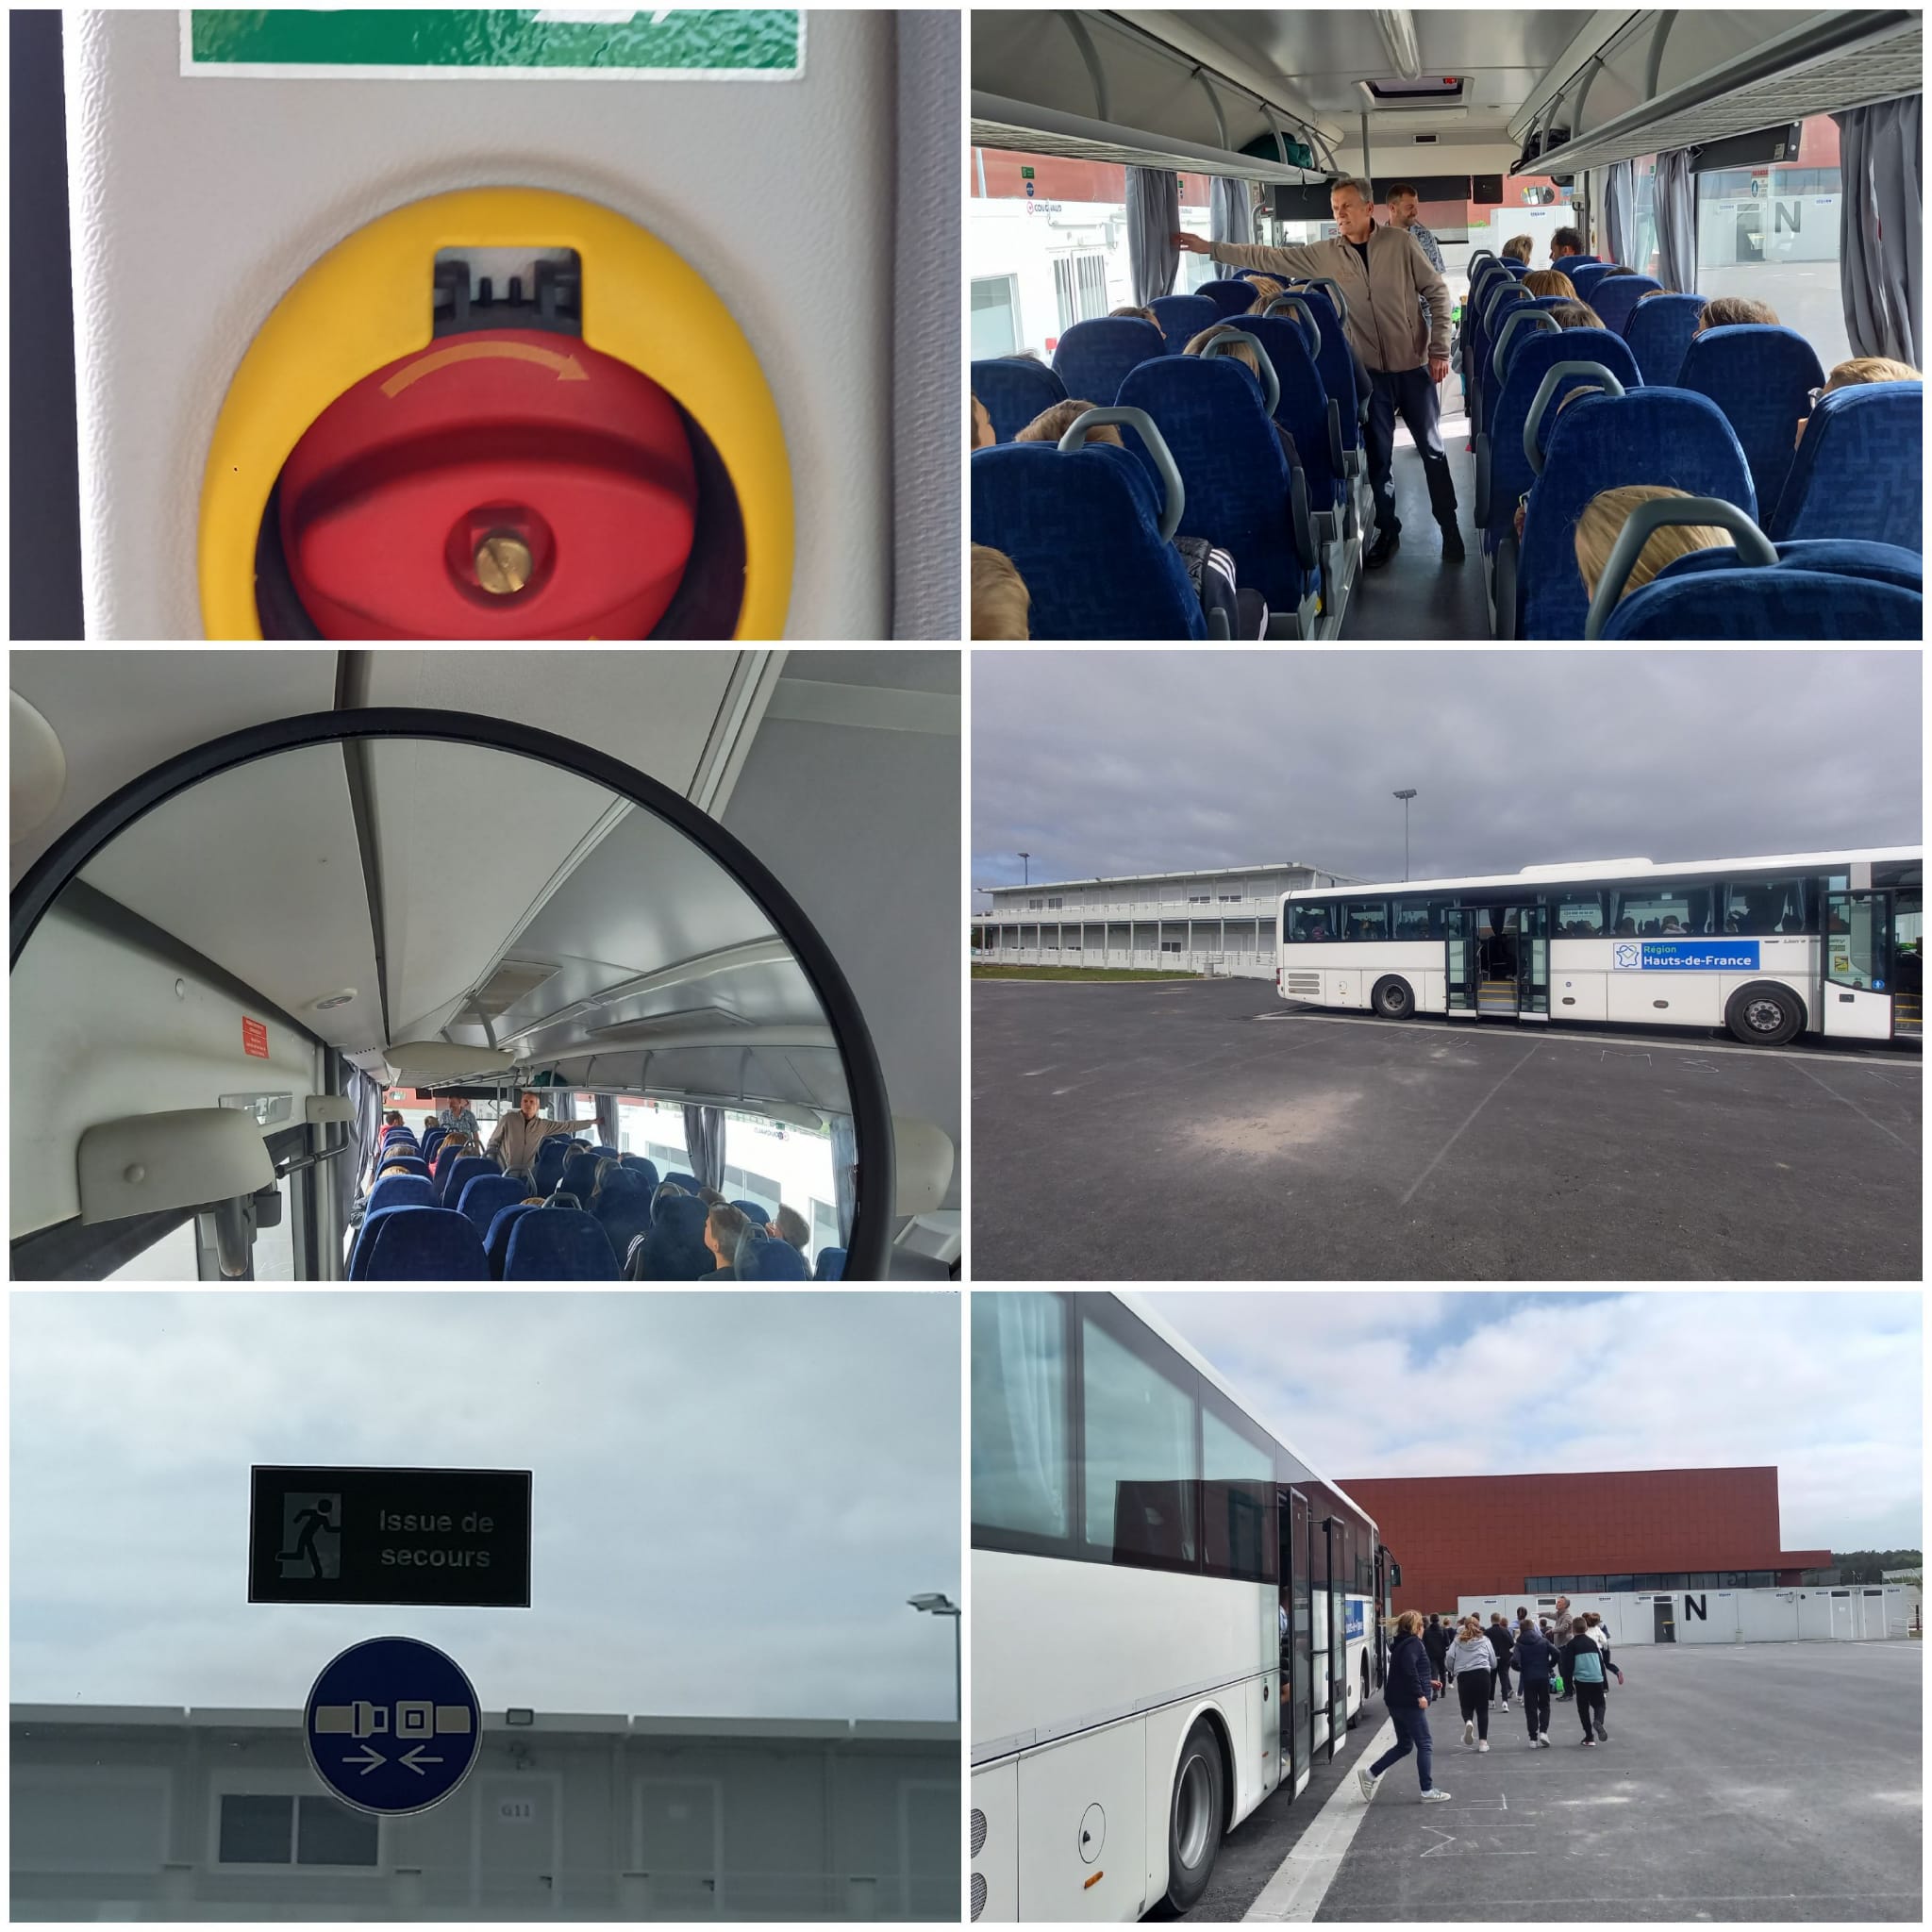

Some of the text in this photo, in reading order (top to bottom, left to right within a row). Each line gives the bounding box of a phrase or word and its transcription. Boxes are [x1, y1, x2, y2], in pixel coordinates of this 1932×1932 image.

[1774, 201, 1801, 233] N
[1643, 945, 1677, 955] Région
[1643, 956, 1752, 966] Hauts-de-France
[379, 1509, 494, 1533] Issue de
[380, 1548, 491, 1567] secours
[1685, 1594, 1707, 1621] N
